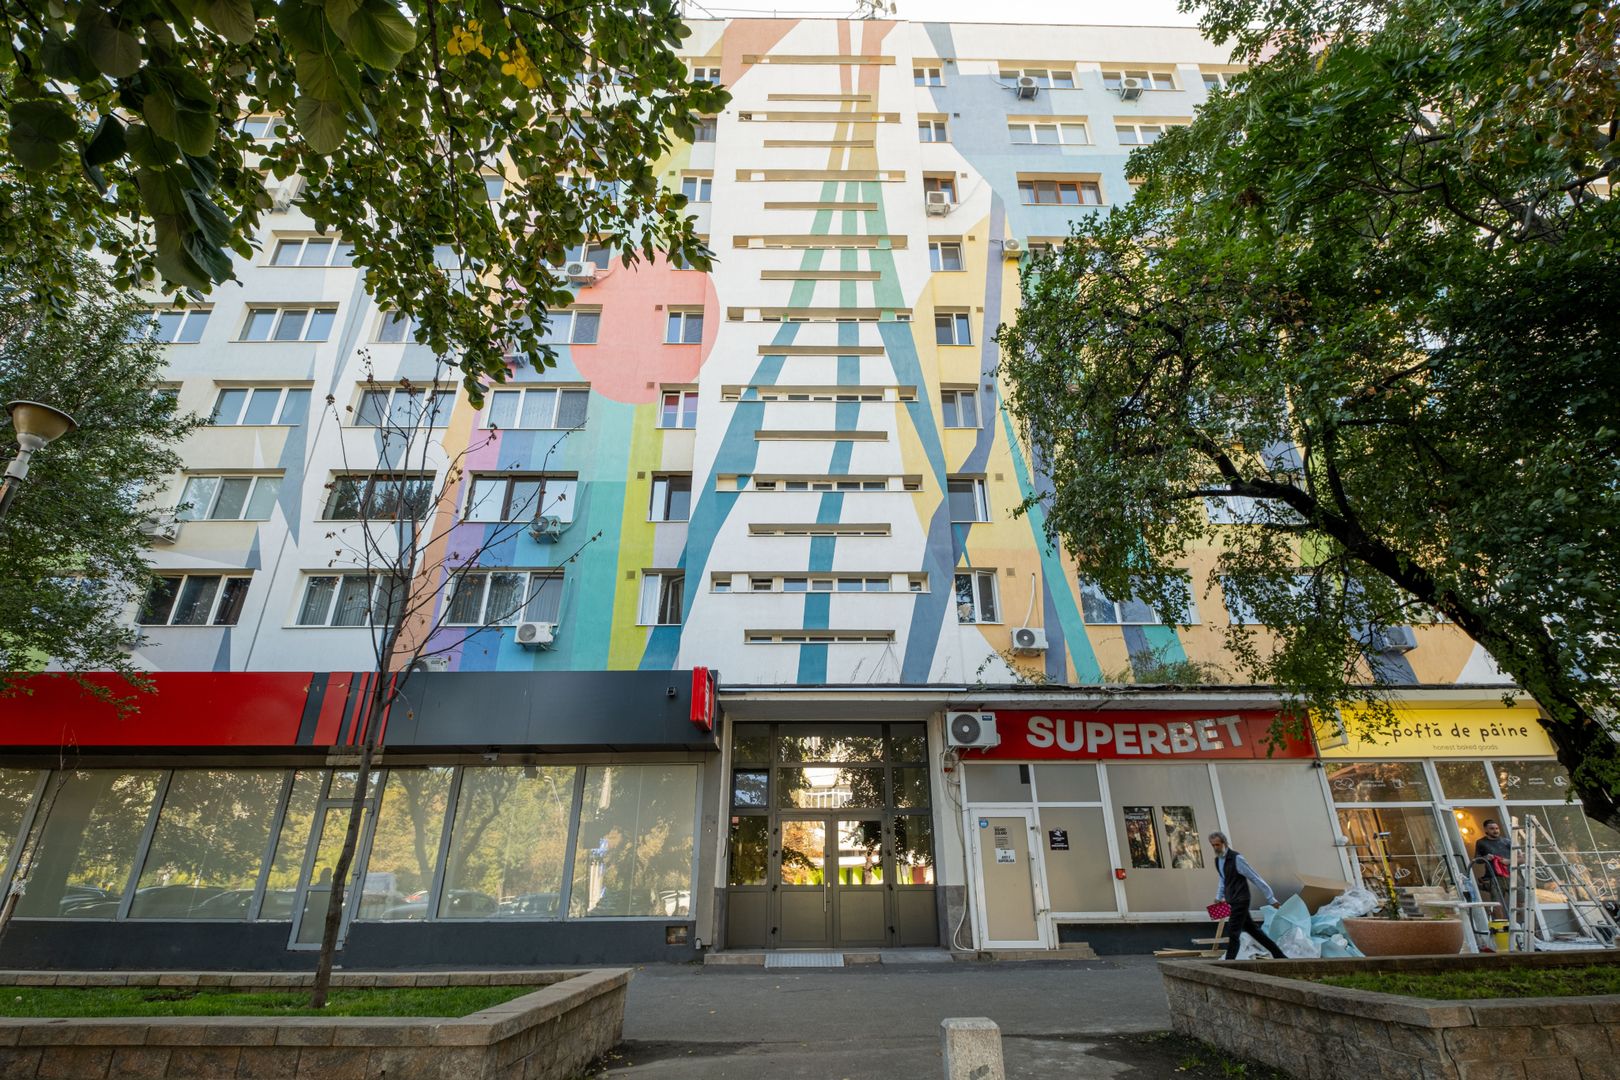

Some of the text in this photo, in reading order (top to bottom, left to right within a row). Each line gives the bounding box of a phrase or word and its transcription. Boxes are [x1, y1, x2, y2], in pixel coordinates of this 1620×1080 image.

[1026, 715, 1242, 755] SUPERBET
[1392, 722, 1528, 743] poftă de pâine
[1479, 743, 1498, 751] goods
